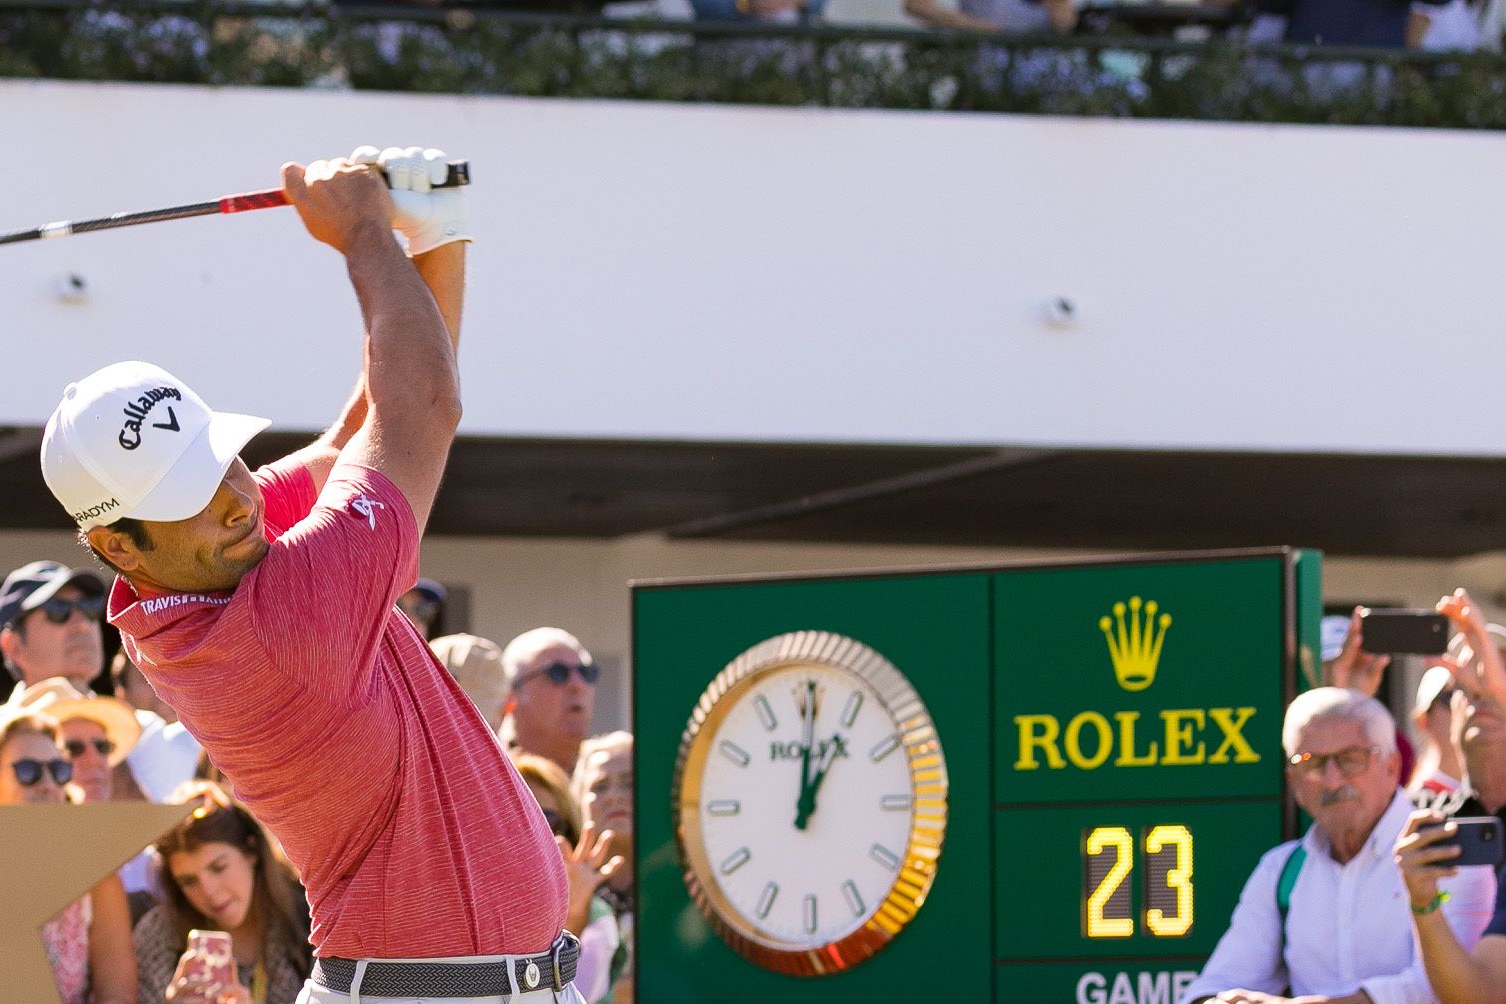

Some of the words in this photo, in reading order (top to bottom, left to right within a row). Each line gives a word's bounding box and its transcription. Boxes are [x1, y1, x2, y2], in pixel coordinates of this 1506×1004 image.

[118, 386, 182, 451] Callaway
[75, 497, 120, 521] RADYM
[1013, 706, 1261, 771] ROLEX
[1086, 824, 1194, 938] 23
